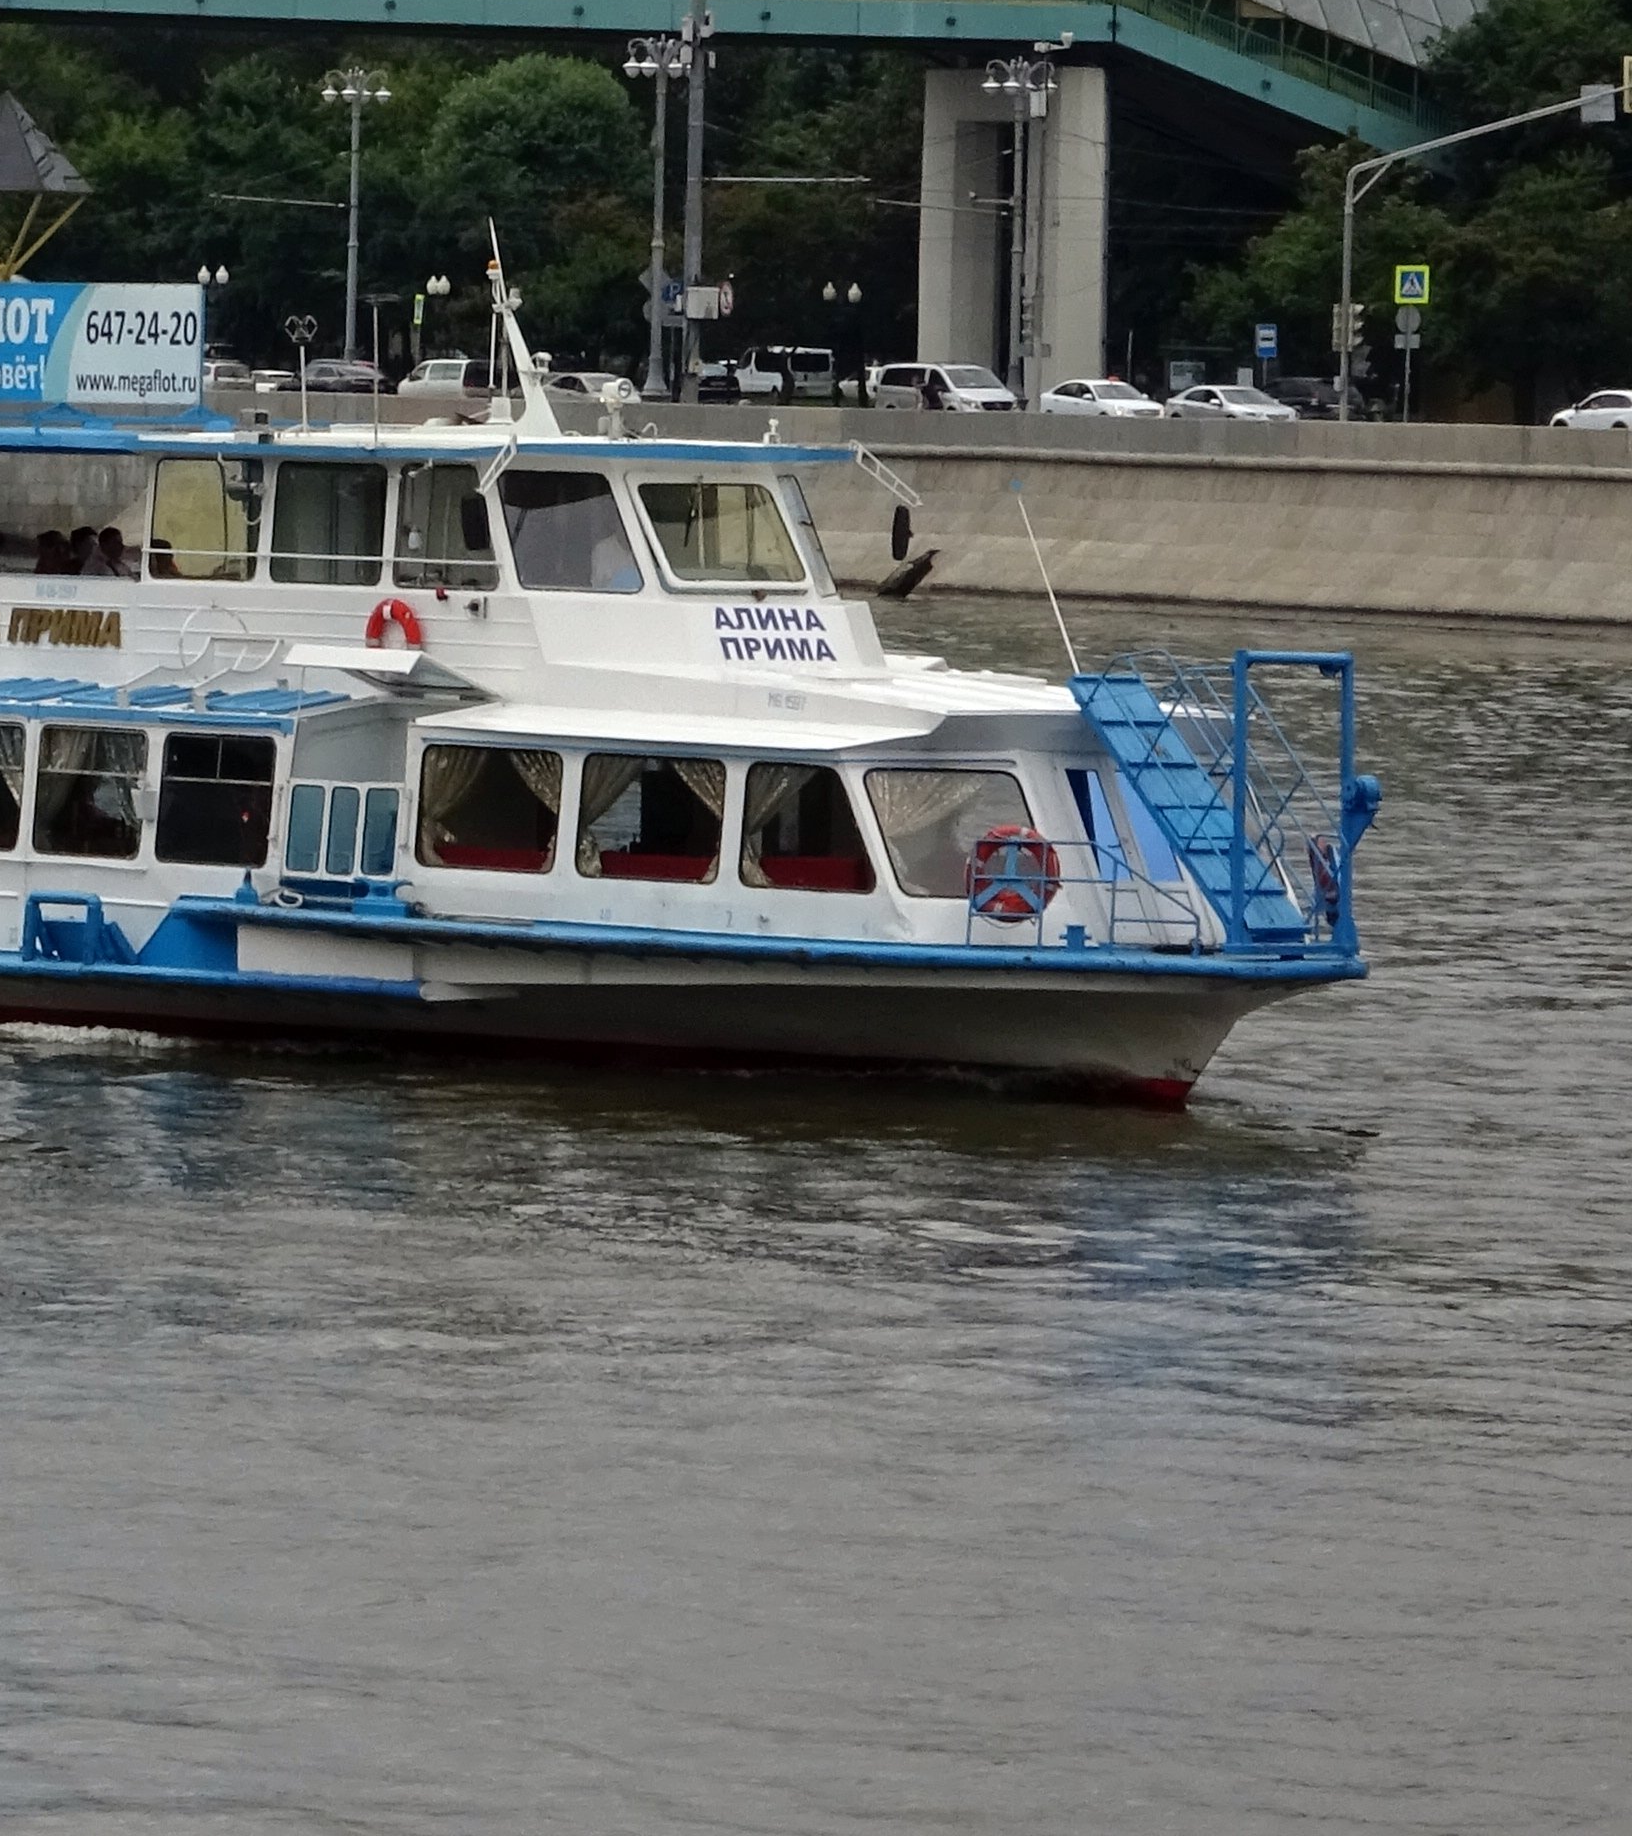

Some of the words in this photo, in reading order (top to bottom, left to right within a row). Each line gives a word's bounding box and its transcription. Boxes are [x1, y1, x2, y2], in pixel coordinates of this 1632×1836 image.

[87, 310, 197, 346] 647-24-20
[76, 368, 197, 397] www.megaflot.ru
[7, 607, 122, 649] ПРИМА
[714, 607, 827, 632] АЛИНА
[720, 637, 837, 662] ПРИМА
